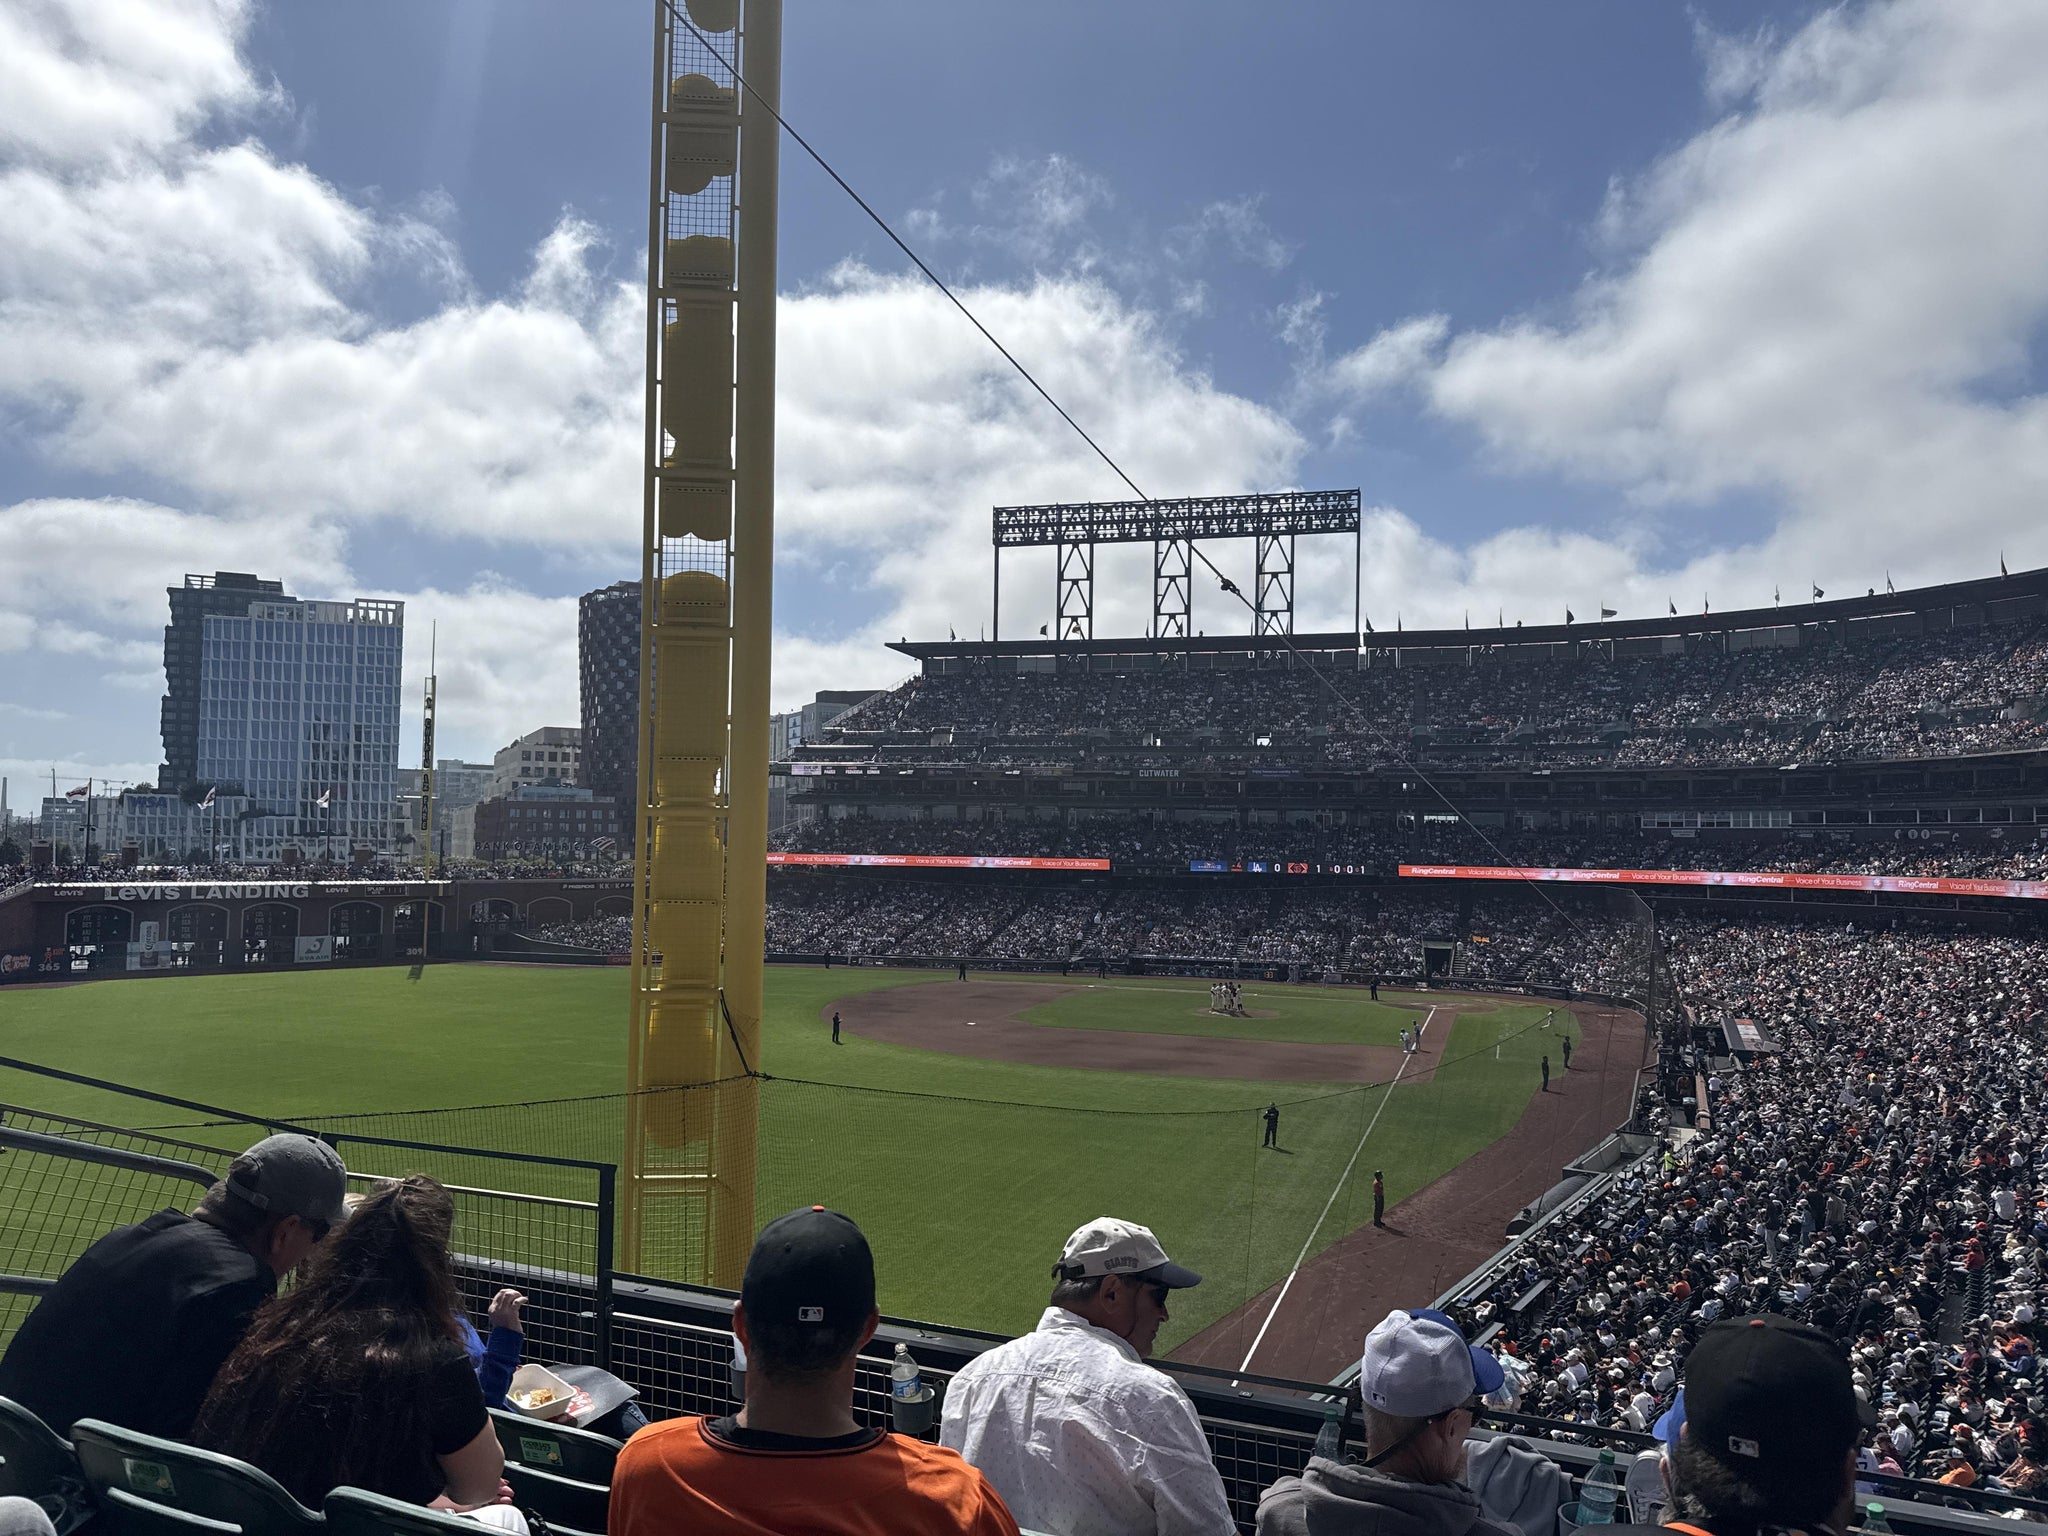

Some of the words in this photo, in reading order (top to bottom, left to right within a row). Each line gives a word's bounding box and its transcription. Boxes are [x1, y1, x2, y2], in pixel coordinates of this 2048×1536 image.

[1139, 769, 1180, 778] CUTWATER
[127, 796, 168, 808] VISA
[475, 841, 510, 850] BANK
[514, 841, 529, 850] OF
[534, 841, 589, 851] AMERICA
[994, 859, 1032, 867] RingCentral
[1274, 863, 1281, 872] 0
[1316, 864, 1321, 873] 1
[1334, 865, 1340, 873] 0
[1346, 865, 1353, 874] 0
[1411, 867, 1456, 876] RingCentral
[1493, 869, 1506, 877] Your
[1573, 871, 1620, 880] RingCentral
[1656, 873, 1671, 881] Your
[1672, 874, 1701, 882] Business
[1738, 874, 1784, 884] RingCentral
[1813, 877, 1820, 885] of
[1821, 878, 1835, 886] Your
[1836, 878, 1862, 887] Business
[1898, 879, 1939, 890] RingCentral
[1949, 882, 1964, 891] Voice
[1973, 883, 1984, 892] Your
[190, 885, 309, 900] LANDING
[406, 948, 423, 956] 309
[38, 962, 61, 972] 365
[1104, 1256, 1139, 1270] GIANTS
